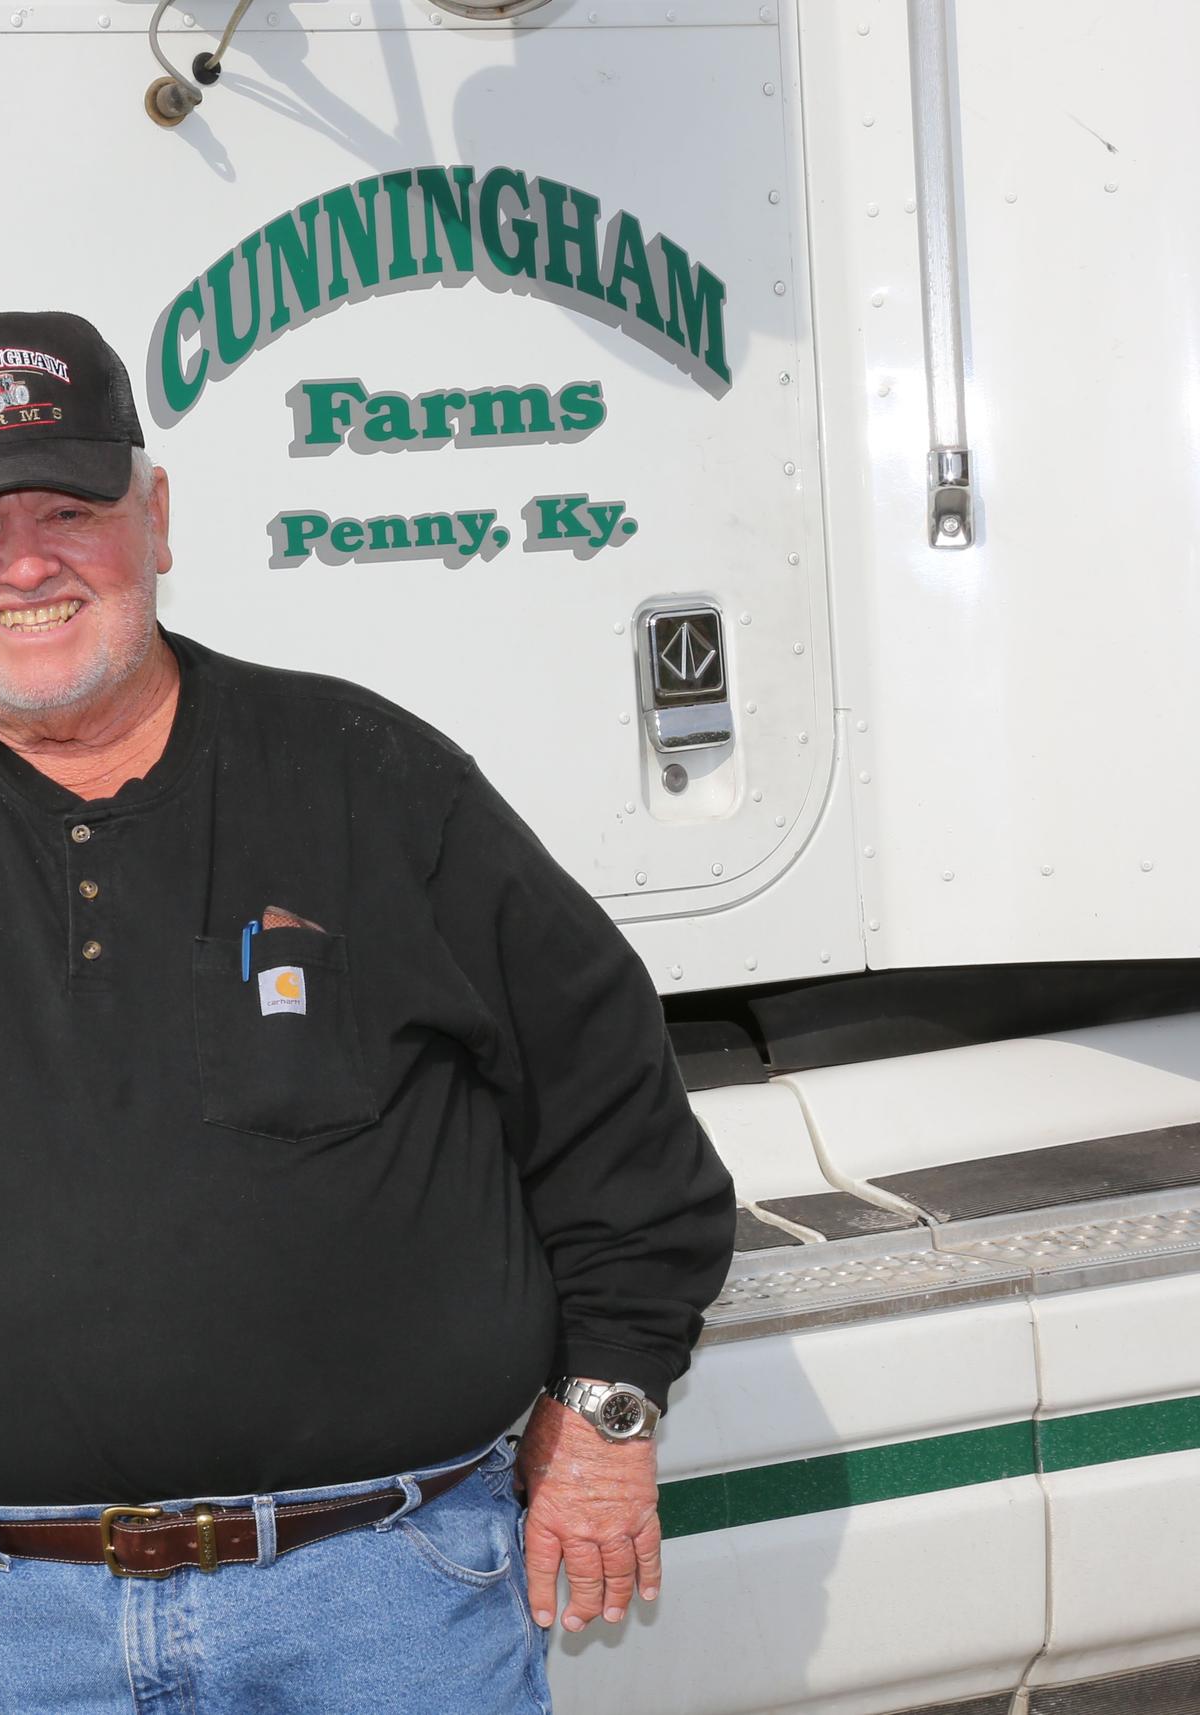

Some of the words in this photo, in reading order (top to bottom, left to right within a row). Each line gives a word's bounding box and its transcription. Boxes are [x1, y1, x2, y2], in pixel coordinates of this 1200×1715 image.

[146, 165, 732, 430] CUNNINGHAM
[285, 377, 607, 458] Farms
[266, 509, 511, 570] Penny,
[521, 493, 638, 561] Ky.
